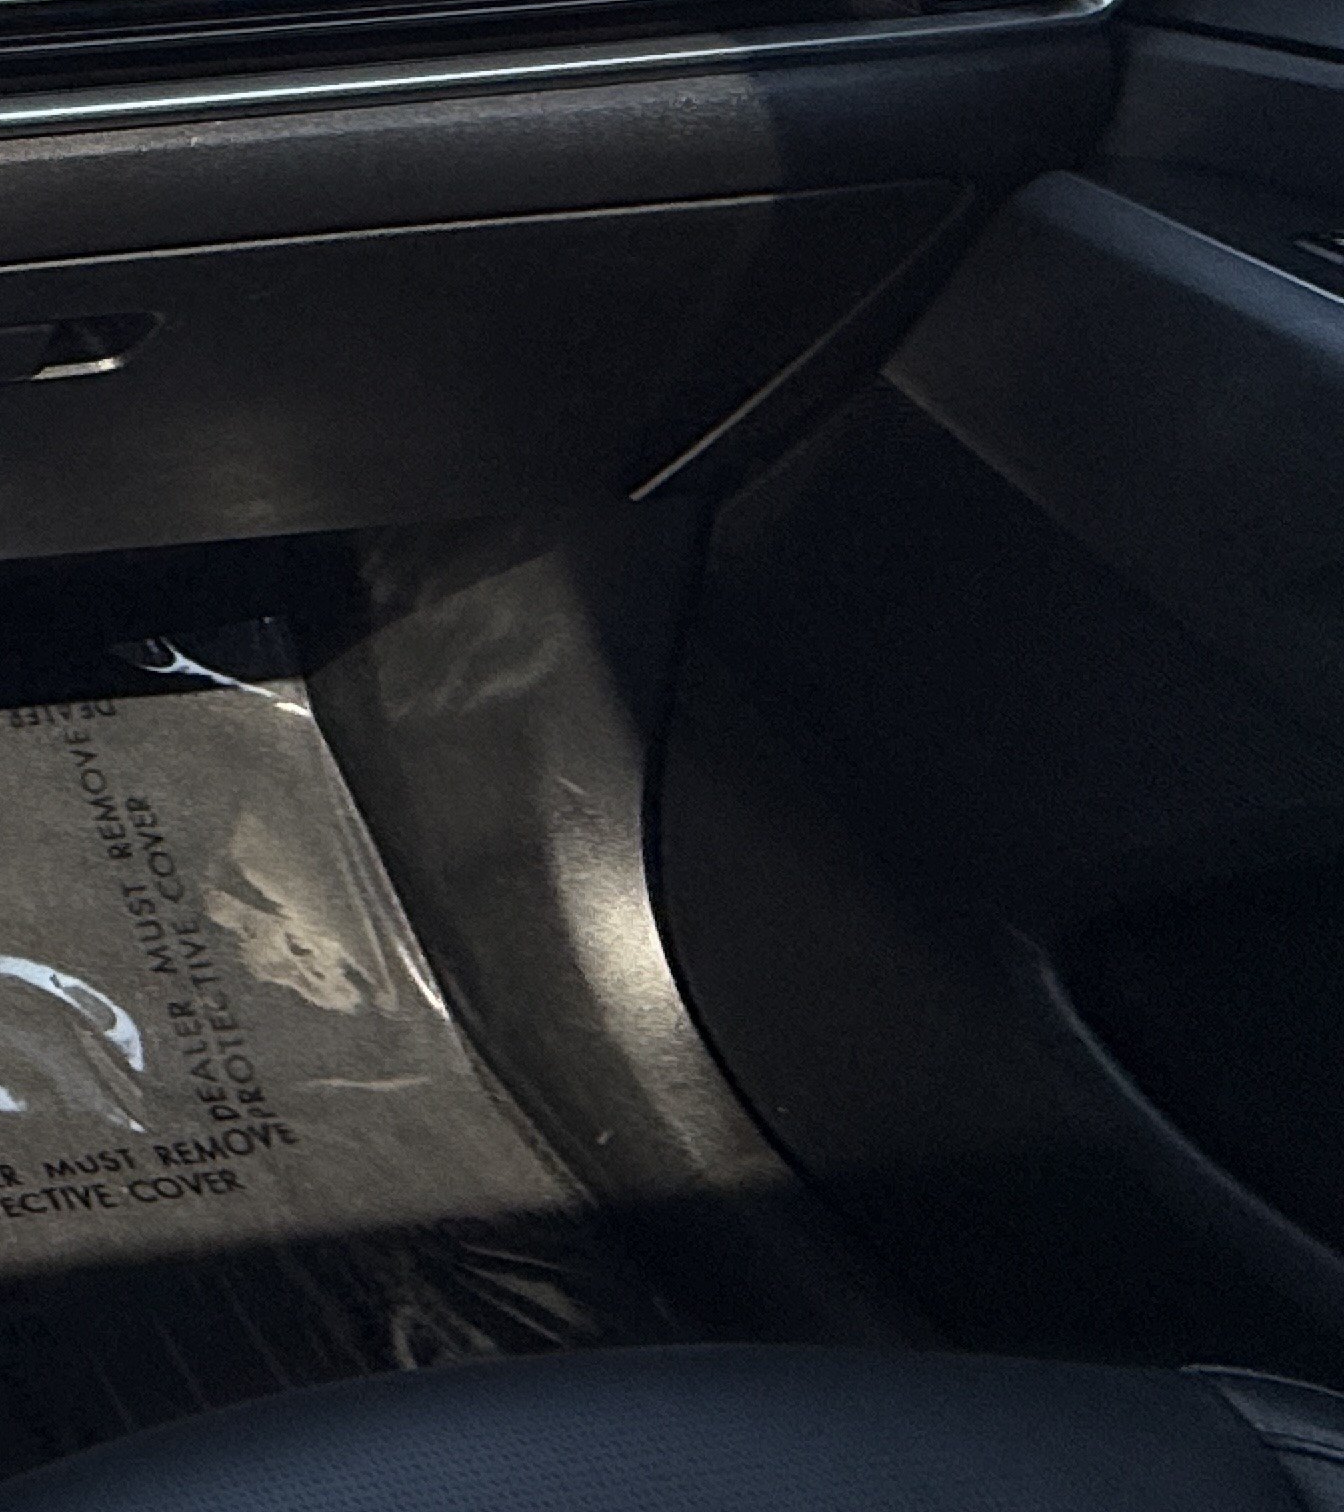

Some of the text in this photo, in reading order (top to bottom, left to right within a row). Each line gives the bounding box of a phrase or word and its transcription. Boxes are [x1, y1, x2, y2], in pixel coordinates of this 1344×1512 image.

[64, 730, 241, 1122] DEALER MUST REMOVE
[125, 795, 278, 1119] PROTECTIVE COVER
[42, 1147, 138, 1179] MUST
[154, 1121, 300, 1169] REMOVE
[126, 1169, 245, 1205] COVER
